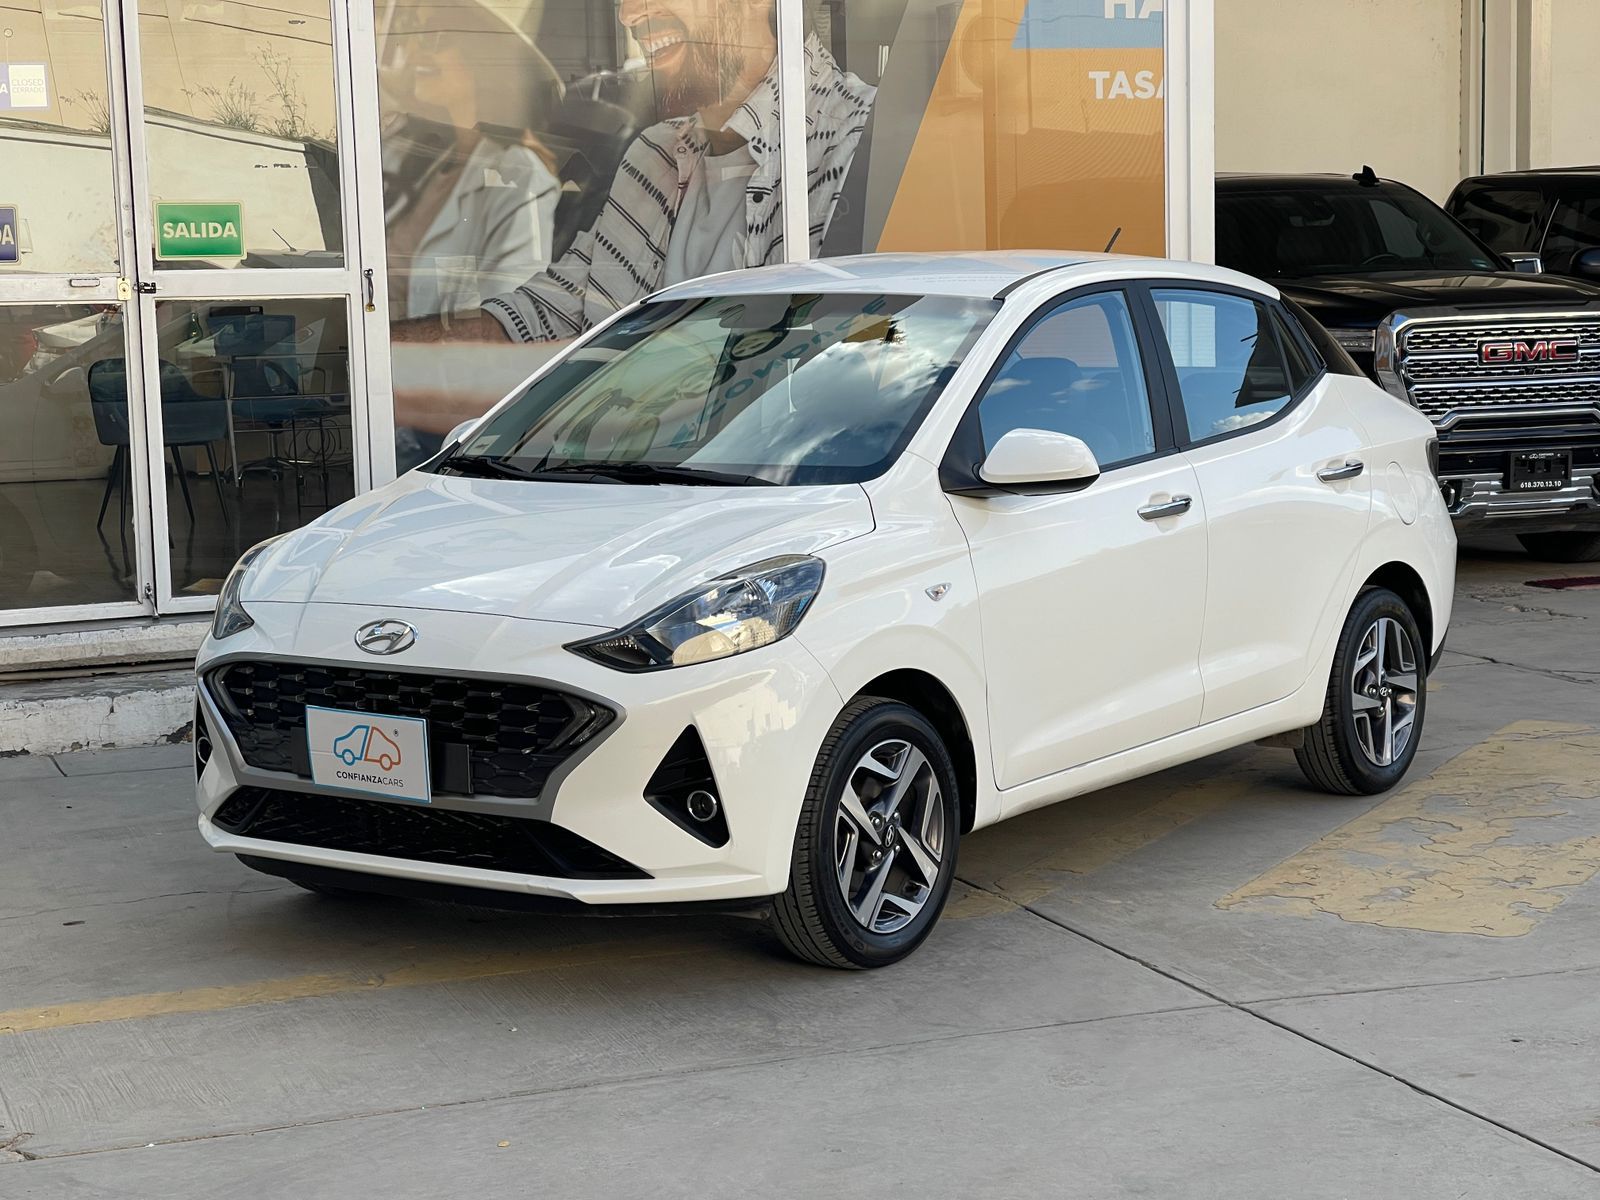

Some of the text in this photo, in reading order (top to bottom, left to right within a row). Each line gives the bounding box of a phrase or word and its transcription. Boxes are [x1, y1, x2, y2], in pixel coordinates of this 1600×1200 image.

[1088, 70, 1164, 100] TAS
[0, 224, 15, 245] A
[163, 222, 238, 239] SALIDA
[1482, 340, 1577, 362] GMC
[1520, 480, 1562, 489] 618.370.13.10
[336, 770, 404, 788] CONFIANZACARS
